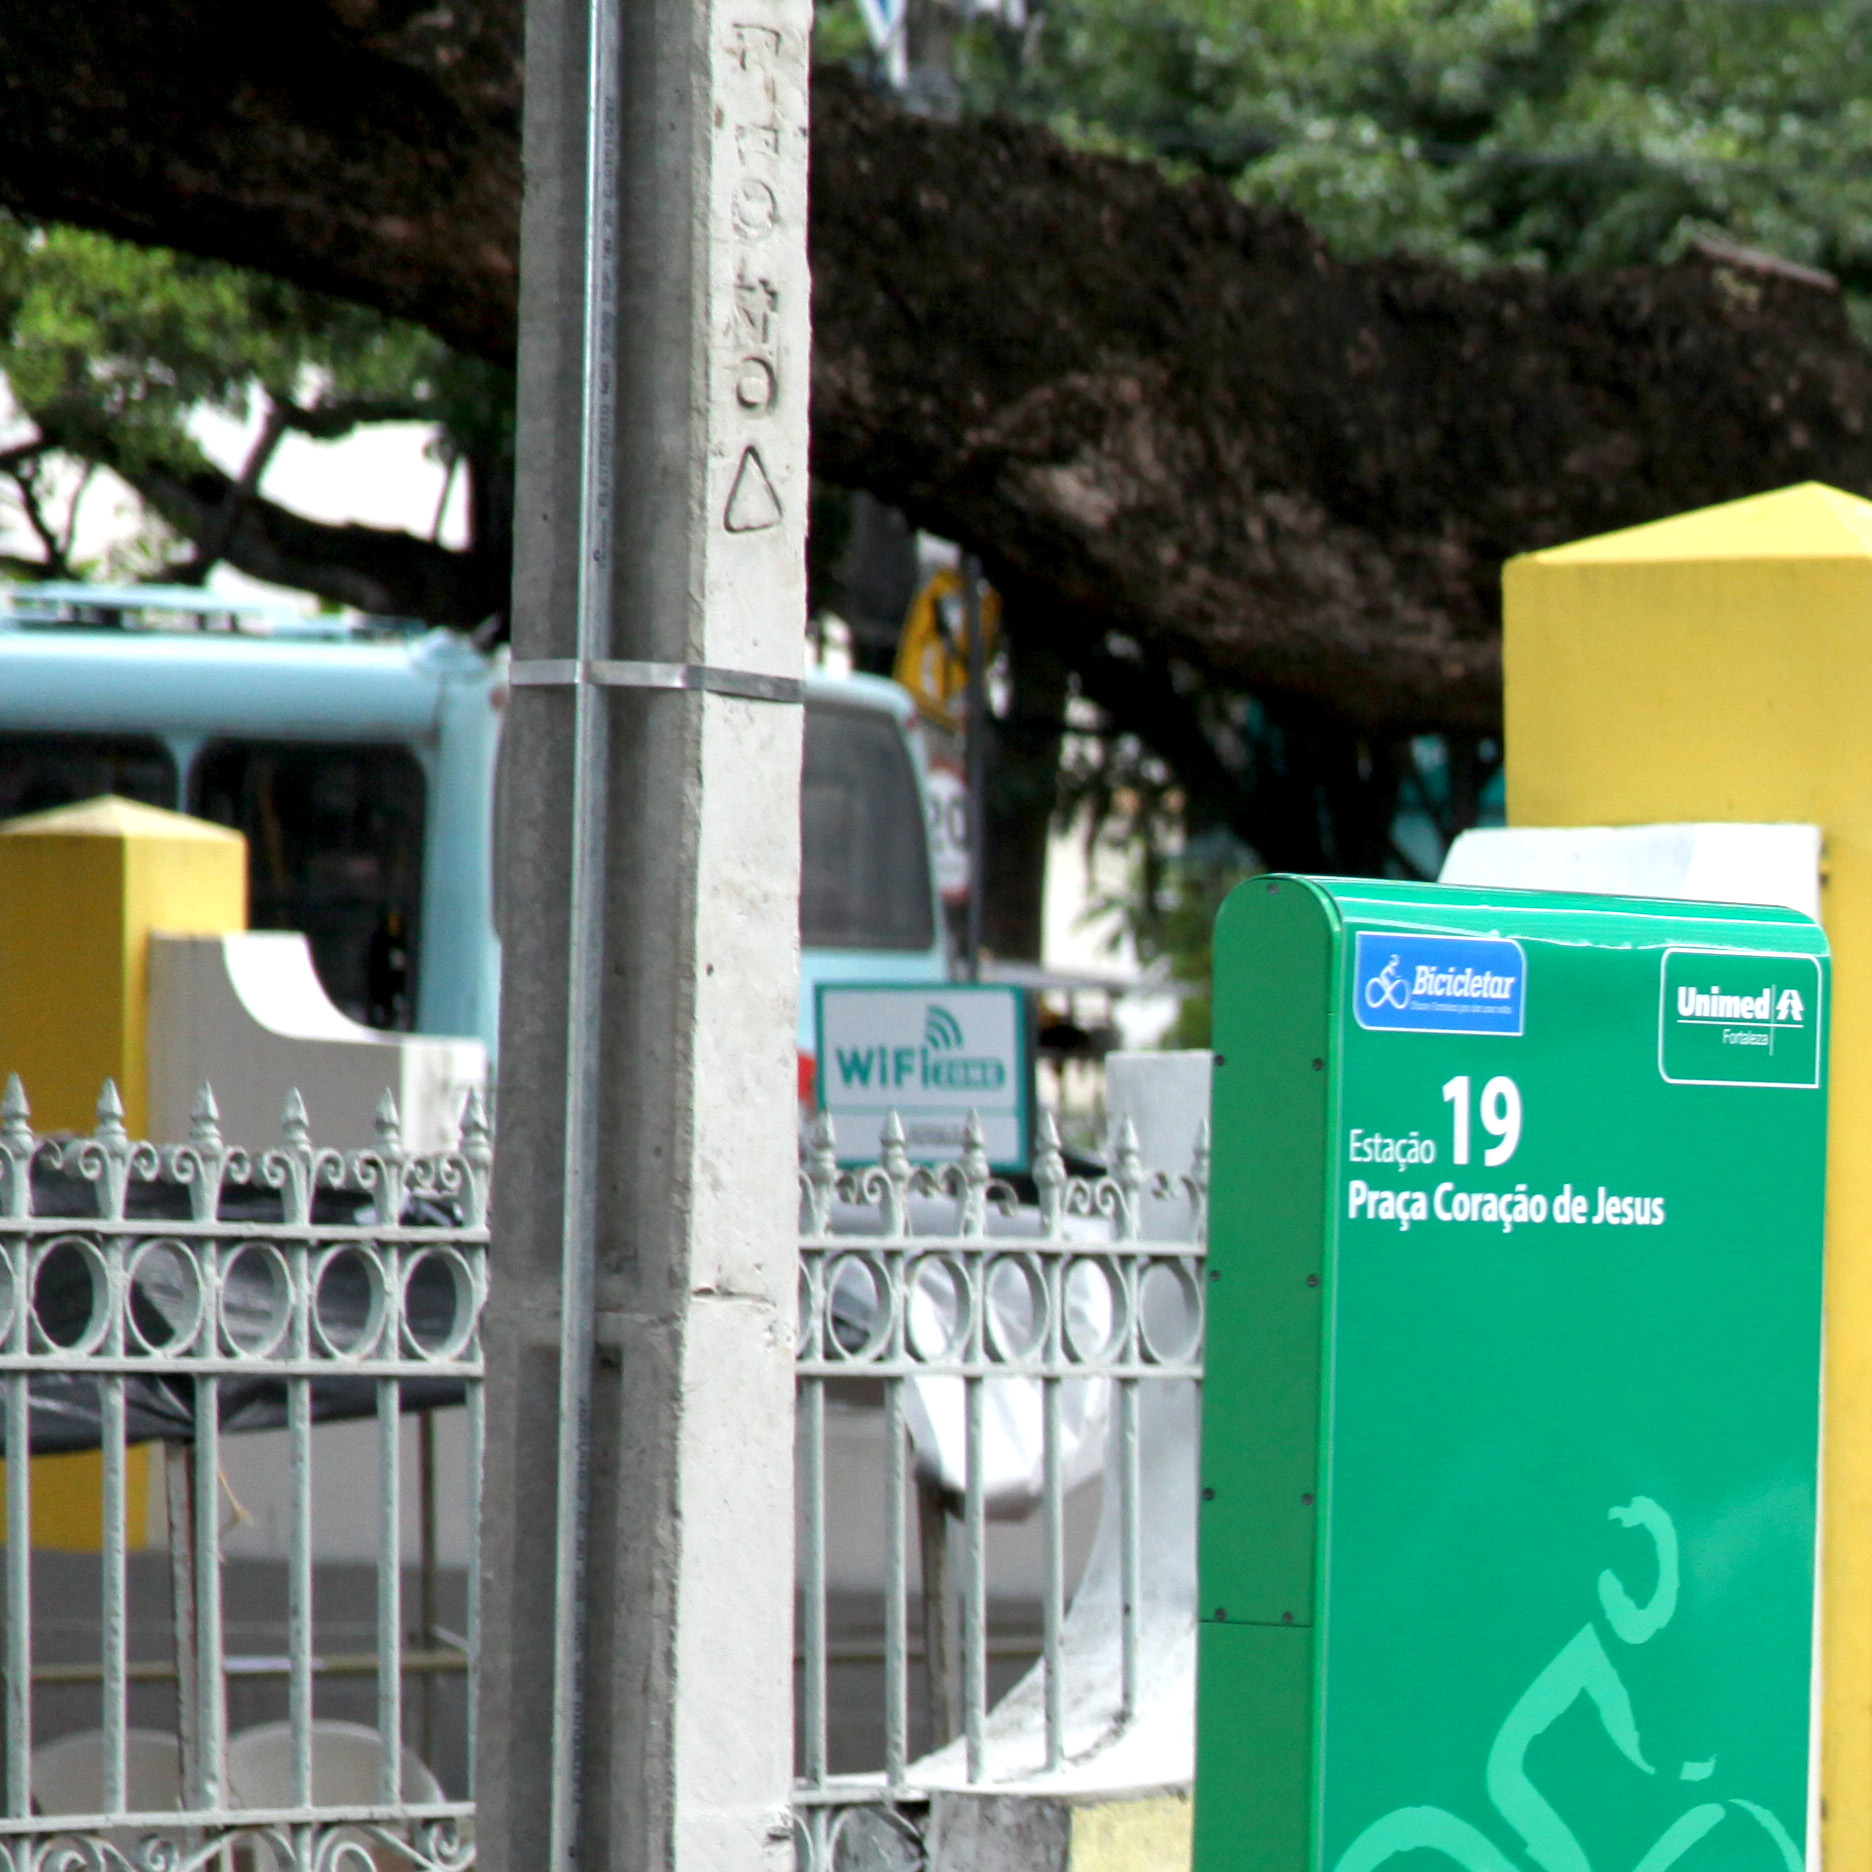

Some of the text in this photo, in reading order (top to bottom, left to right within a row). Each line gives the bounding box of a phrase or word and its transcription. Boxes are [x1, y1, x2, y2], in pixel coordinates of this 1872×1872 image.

[1412, 965, 1516, 999] Bicicletar
[1677, 986, 1770, 1019] Unimed
[1722, 1028, 1770, 1046] Fortaleza
[1349, 1074, 1523, 1172] Estação 19
[1348, 1179, 1666, 1233] Praça Coração de Jesus
